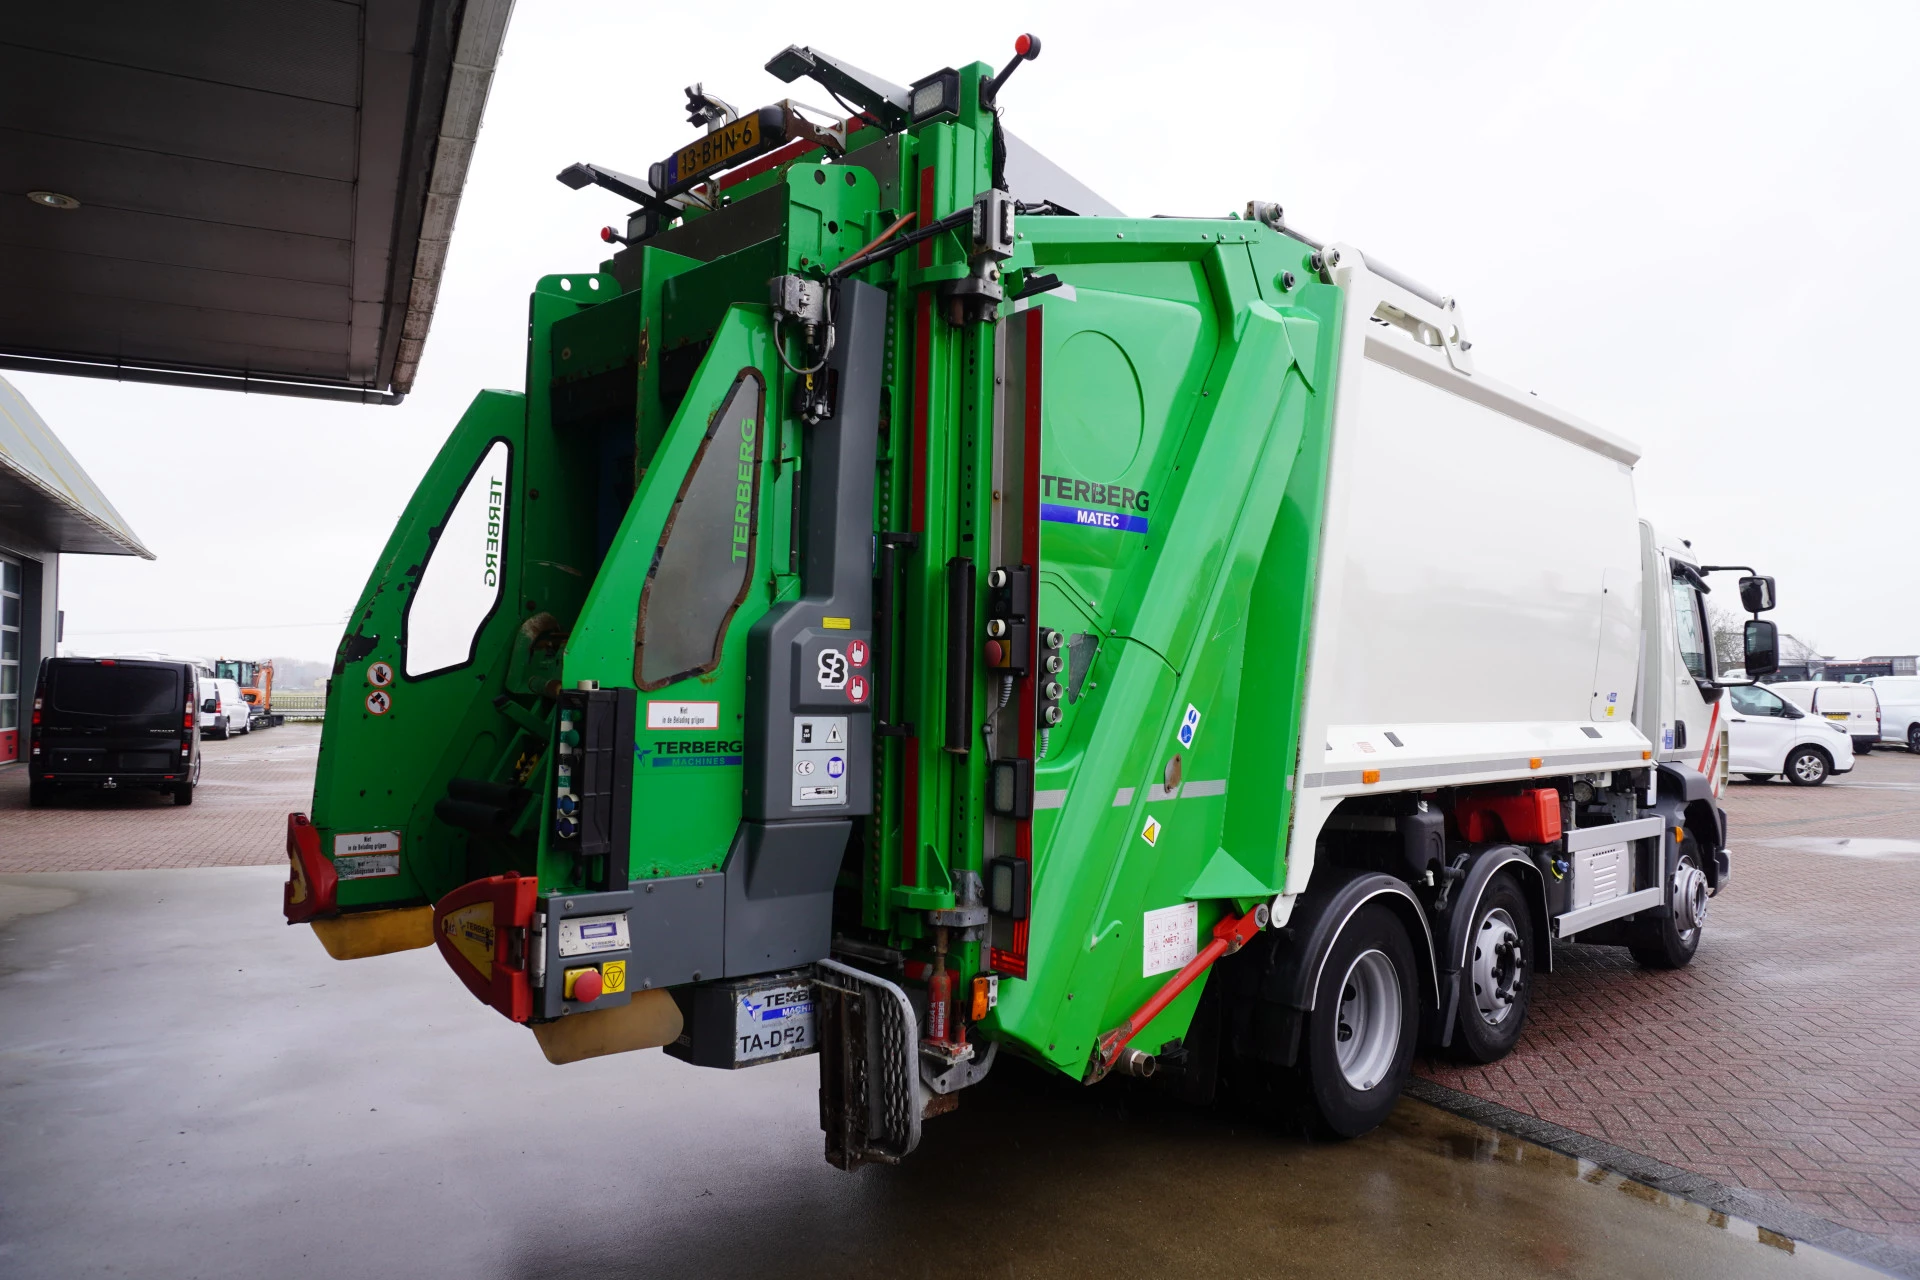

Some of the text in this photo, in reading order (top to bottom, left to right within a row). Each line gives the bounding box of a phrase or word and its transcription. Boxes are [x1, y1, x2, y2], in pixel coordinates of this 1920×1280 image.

[681, 120, 752, 174] 13-BHN-6
[731, 417, 756, 564] TERBERG
[1041, 474, 1149, 512] TERBERG
[1077, 510, 1120, 528] MATEC
[680, 706, 688, 714] Niet
[653, 740, 743, 755] TERBERG
[672, 757, 726, 766] MACHINES
[740, 1026, 805, 1053] TA-DE2
